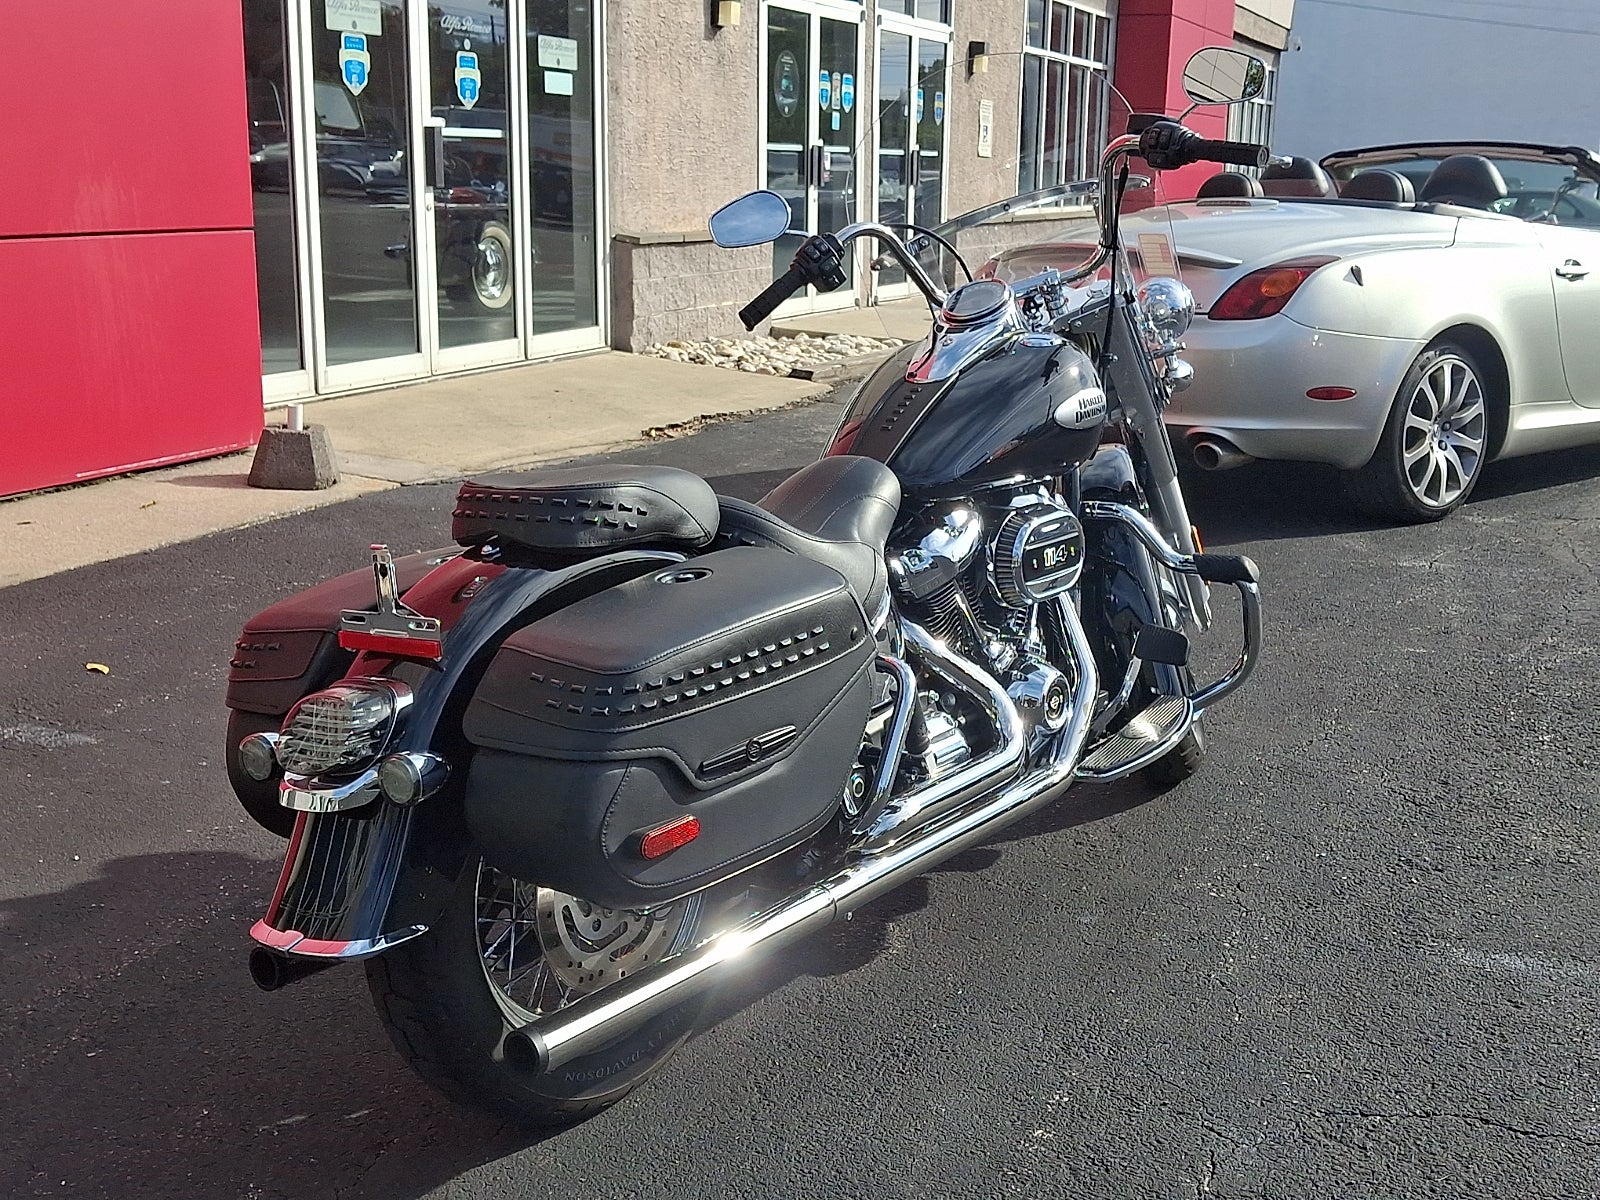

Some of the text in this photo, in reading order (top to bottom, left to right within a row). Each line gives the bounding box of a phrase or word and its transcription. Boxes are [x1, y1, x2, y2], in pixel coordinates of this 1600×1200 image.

[440, 14, 491, 35] Alfa Romeo
[1075, 404, 1106, 424] DAVIDSO
[1043, 544, 1068, 567] 114
